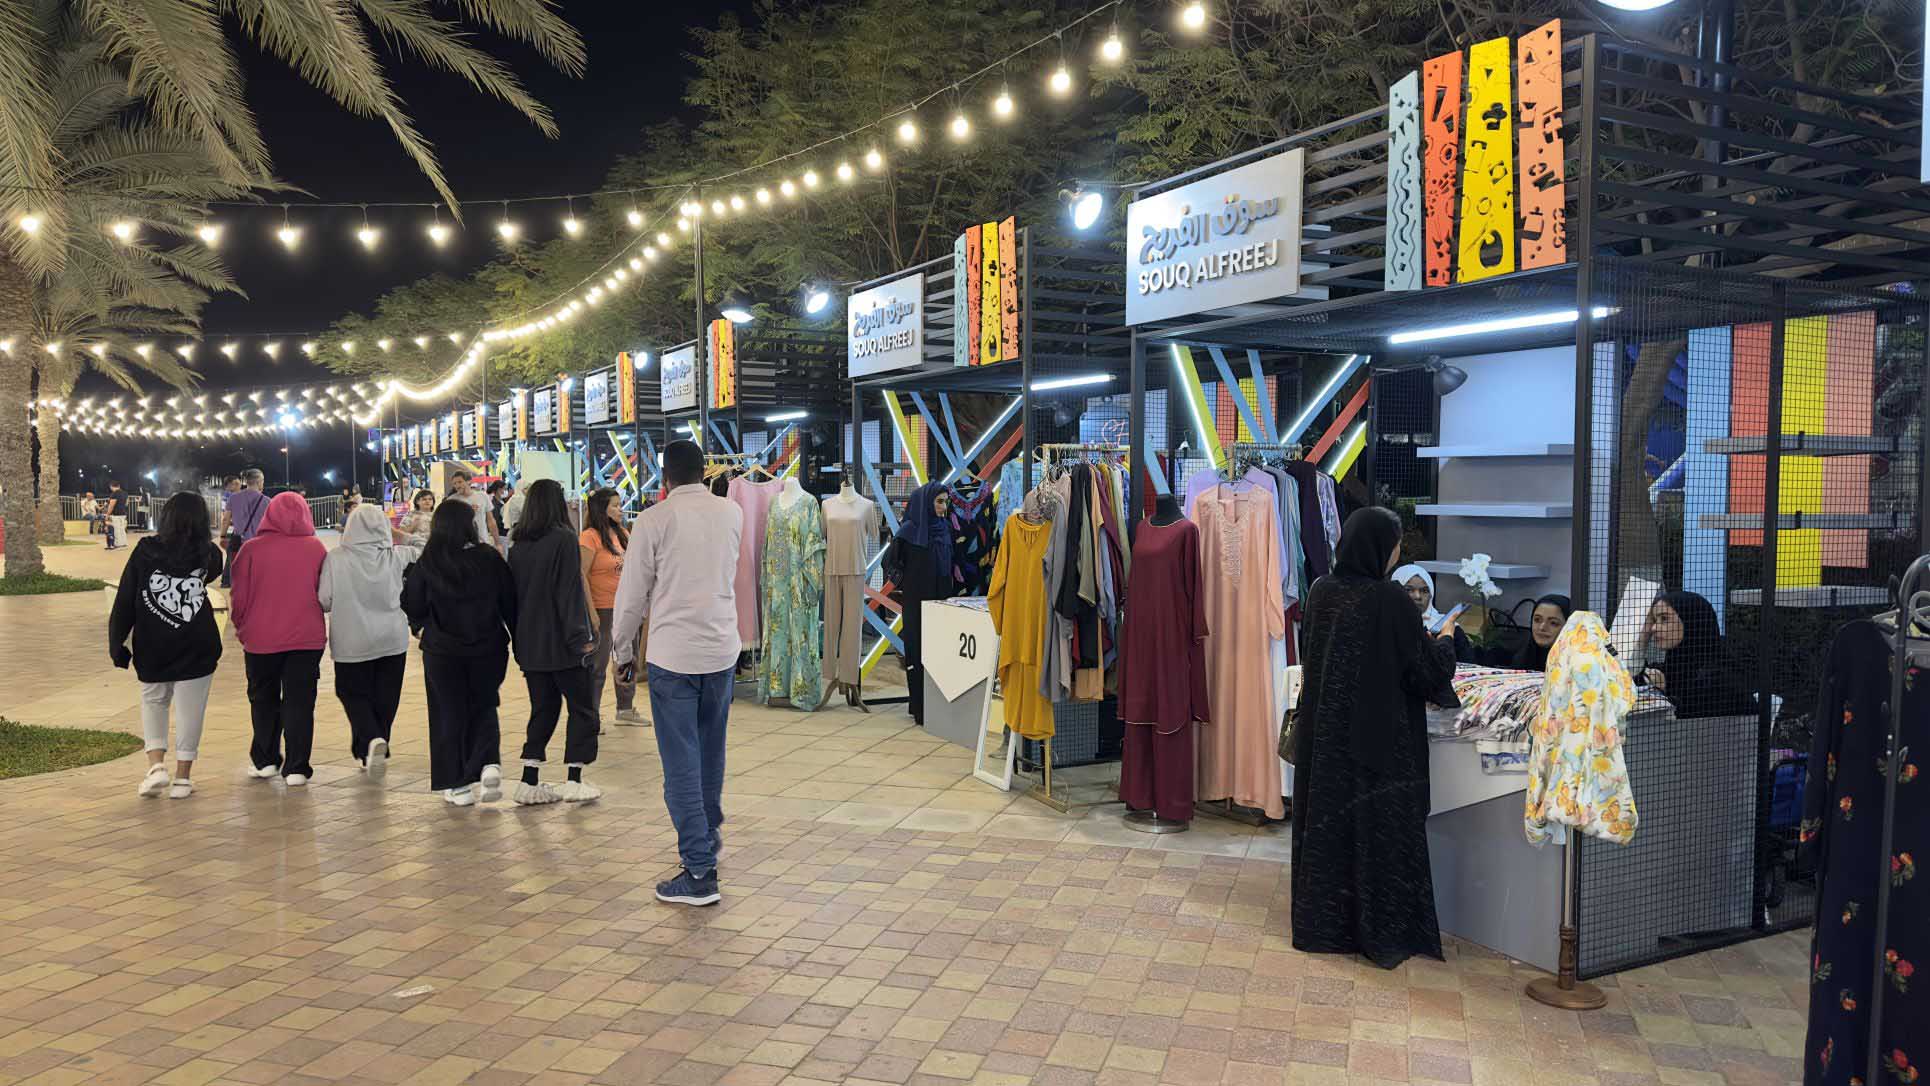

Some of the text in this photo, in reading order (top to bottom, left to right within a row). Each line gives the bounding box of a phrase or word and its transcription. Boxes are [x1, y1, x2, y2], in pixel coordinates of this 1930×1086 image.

[1139, 193, 1280, 264] سوق الفريج
[1138, 238, 1280, 295] SOUQ ALFREEJ
[886, 297, 915, 325] سوق
[853, 328, 915, 358] SOUQ ALFREEJ
[959, 632, 976, 660] 20
